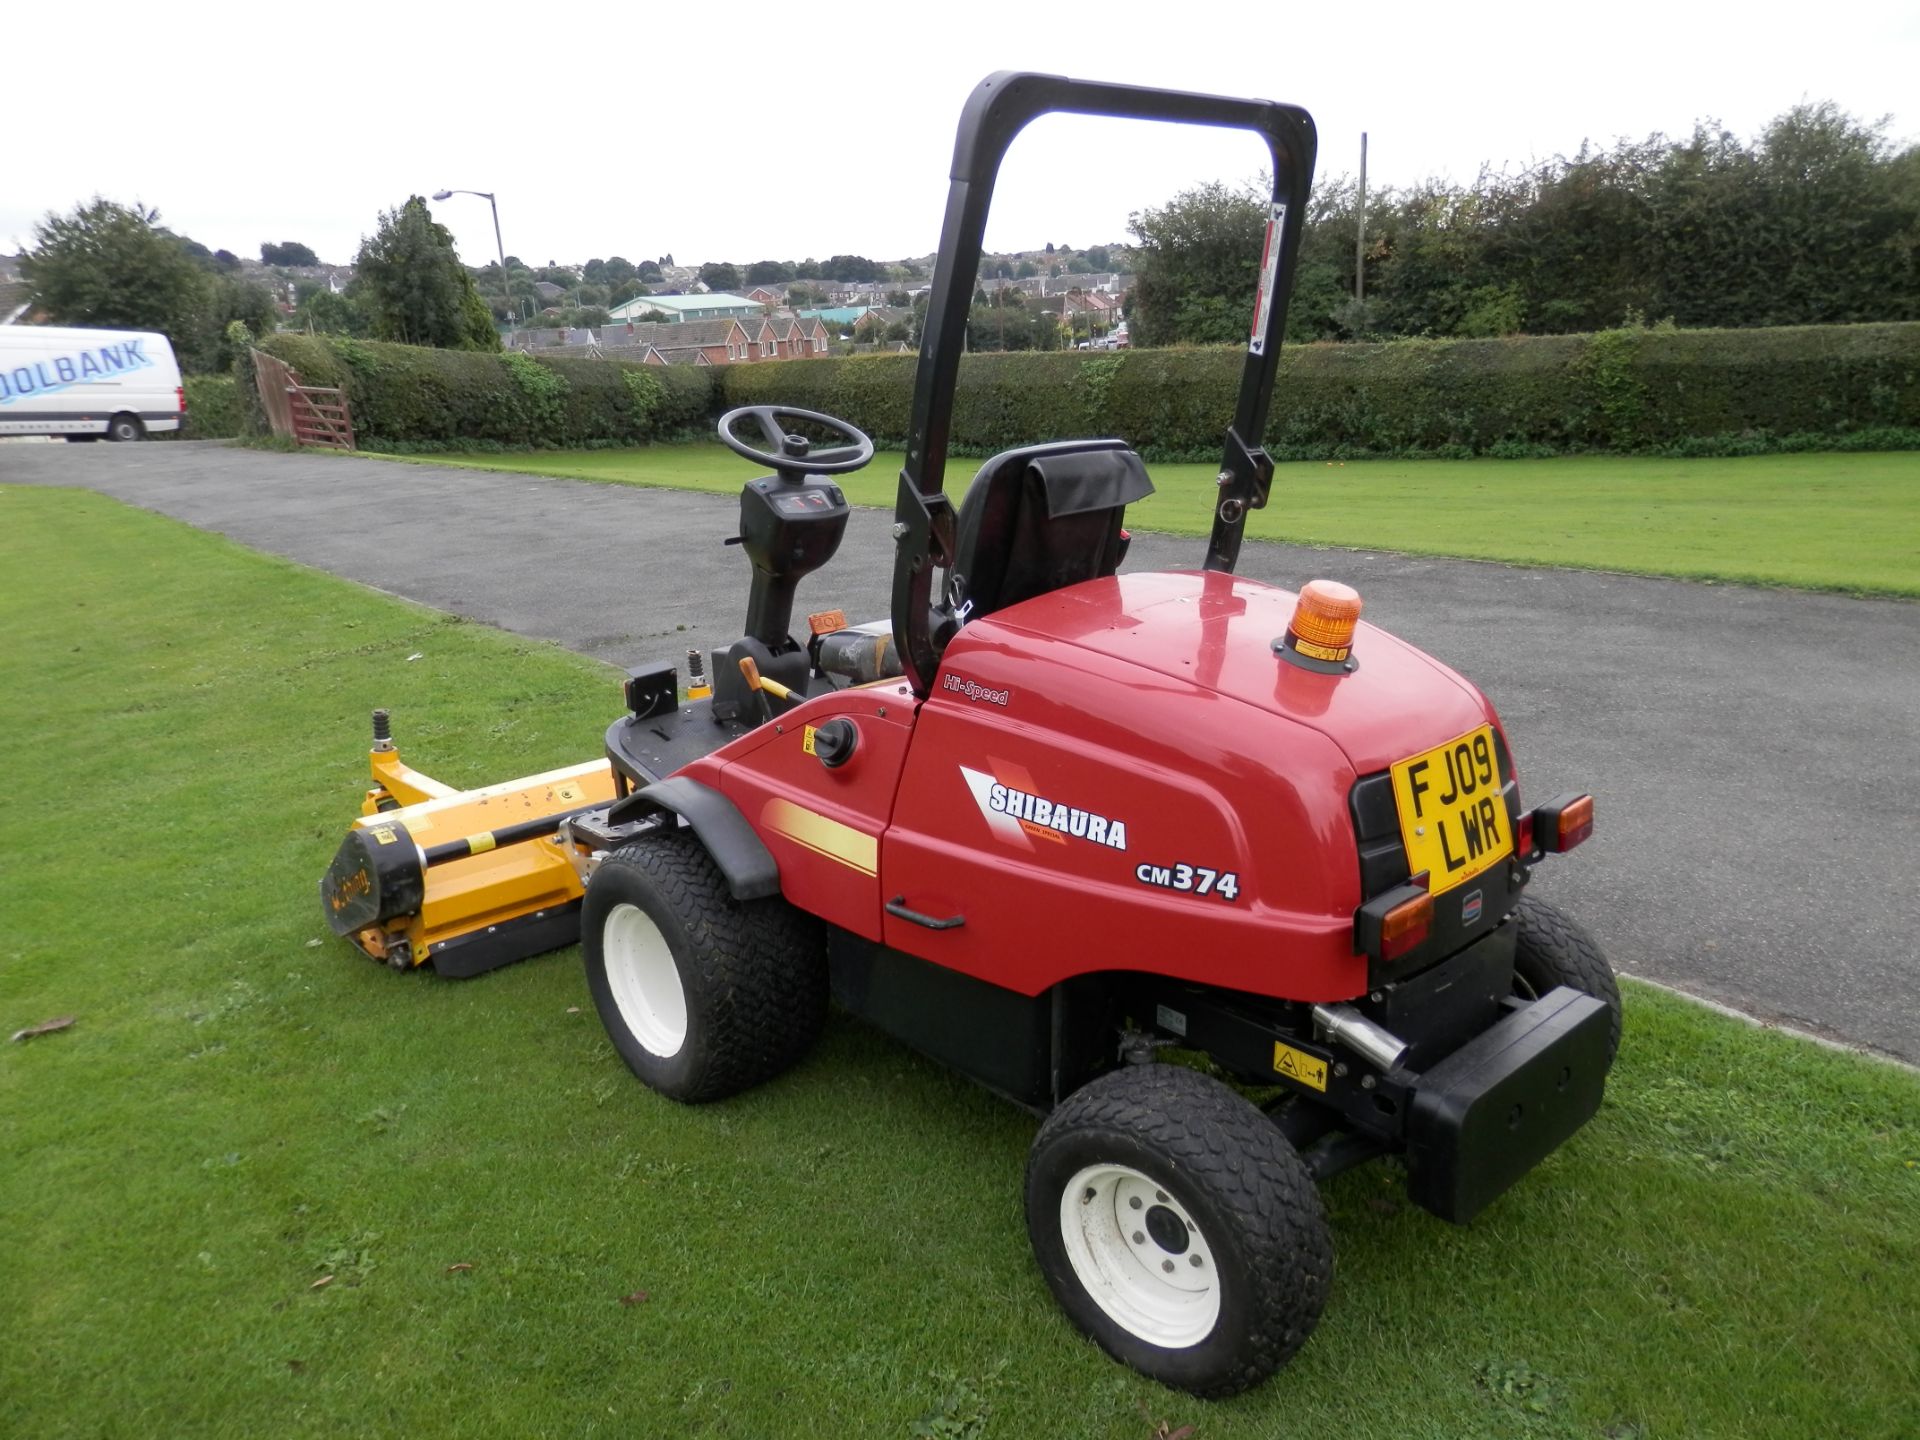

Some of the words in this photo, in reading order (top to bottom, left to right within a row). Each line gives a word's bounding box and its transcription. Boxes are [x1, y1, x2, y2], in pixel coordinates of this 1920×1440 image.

[943, 674, 1009, 706] Hi-Speed
[989, 782, 1127, 851] SHIBAURA
[1436, 796, 1501, 873] LWR
